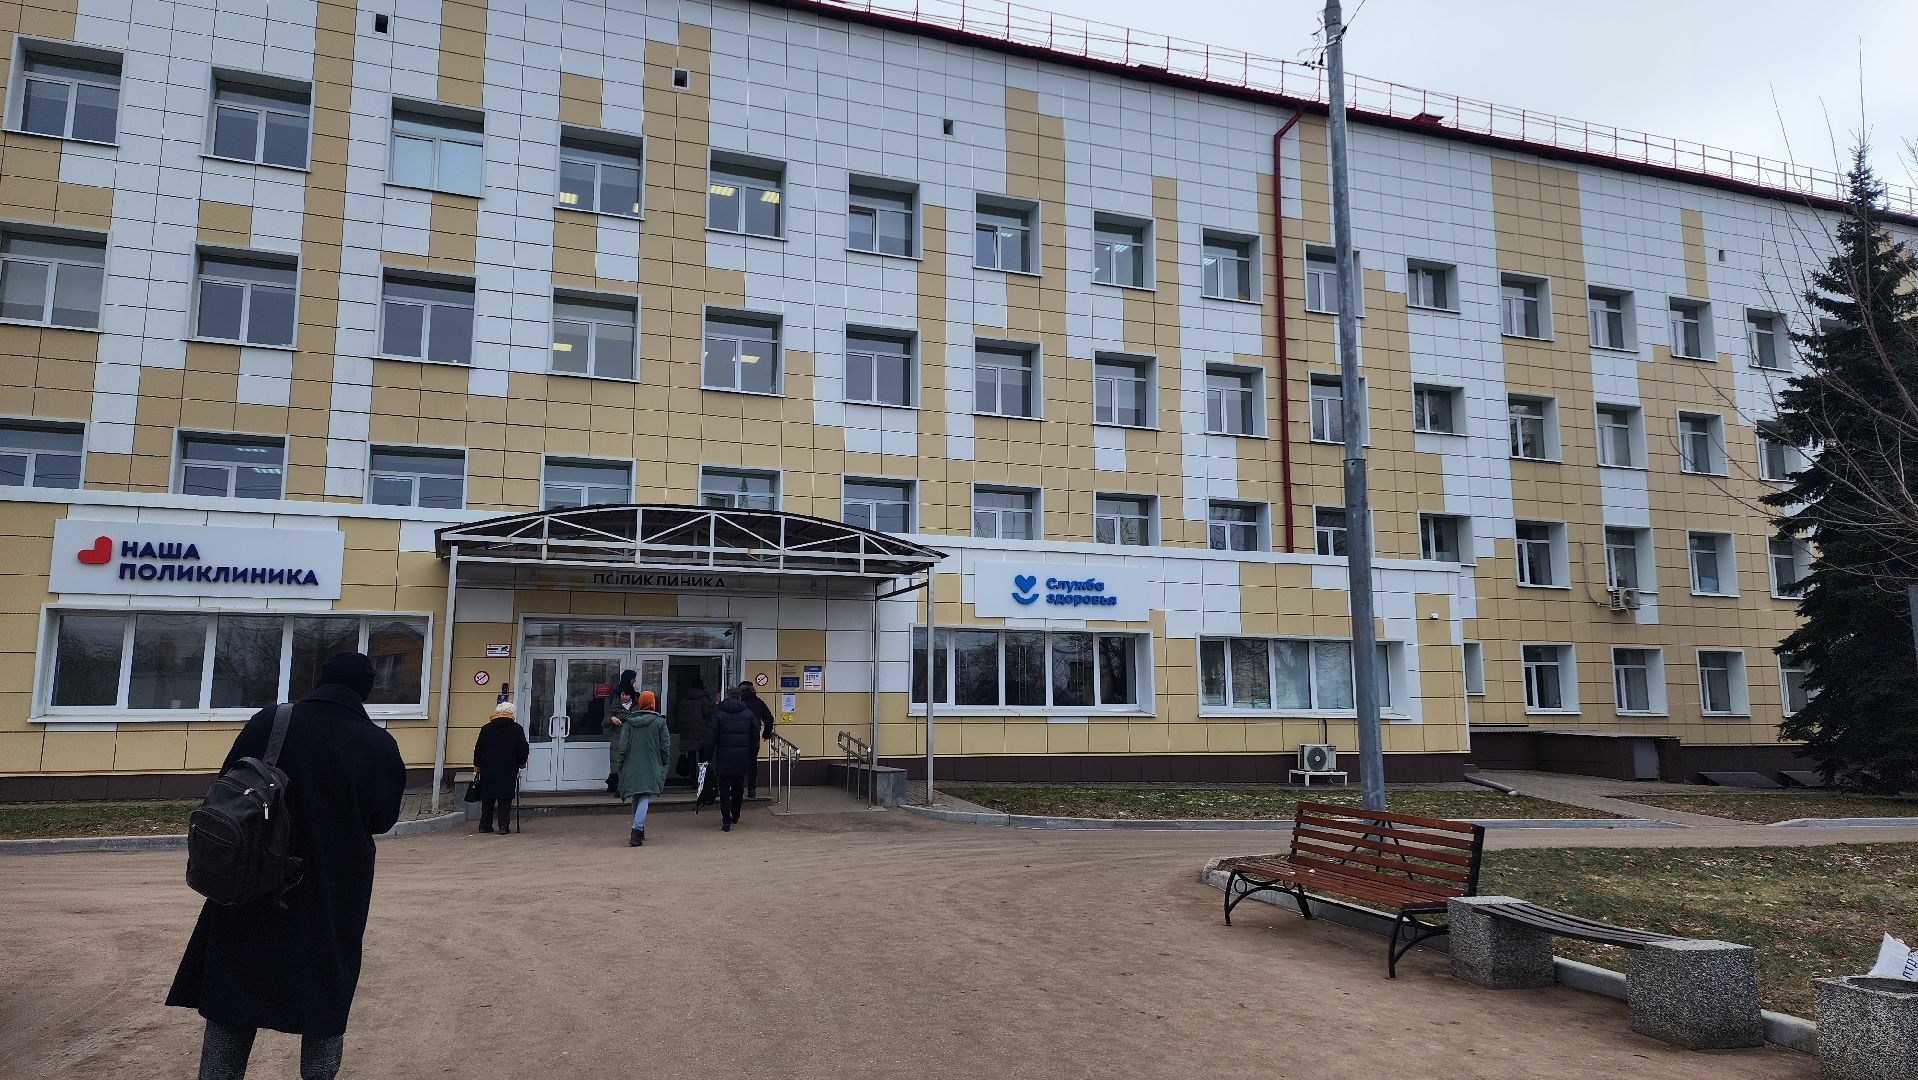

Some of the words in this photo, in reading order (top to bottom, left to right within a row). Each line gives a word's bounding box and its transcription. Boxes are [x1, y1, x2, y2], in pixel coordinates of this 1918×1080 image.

[121, 540, 200, 560] НАША
[118, 562, 319, 586] ПОЛИКЛИНИКА
[593, 573, 726, 588] ПОЛИКЛИНИКА
[1045, 577, 1104, 593] Служба
[1045, 593, 1118, 607] здоровья
